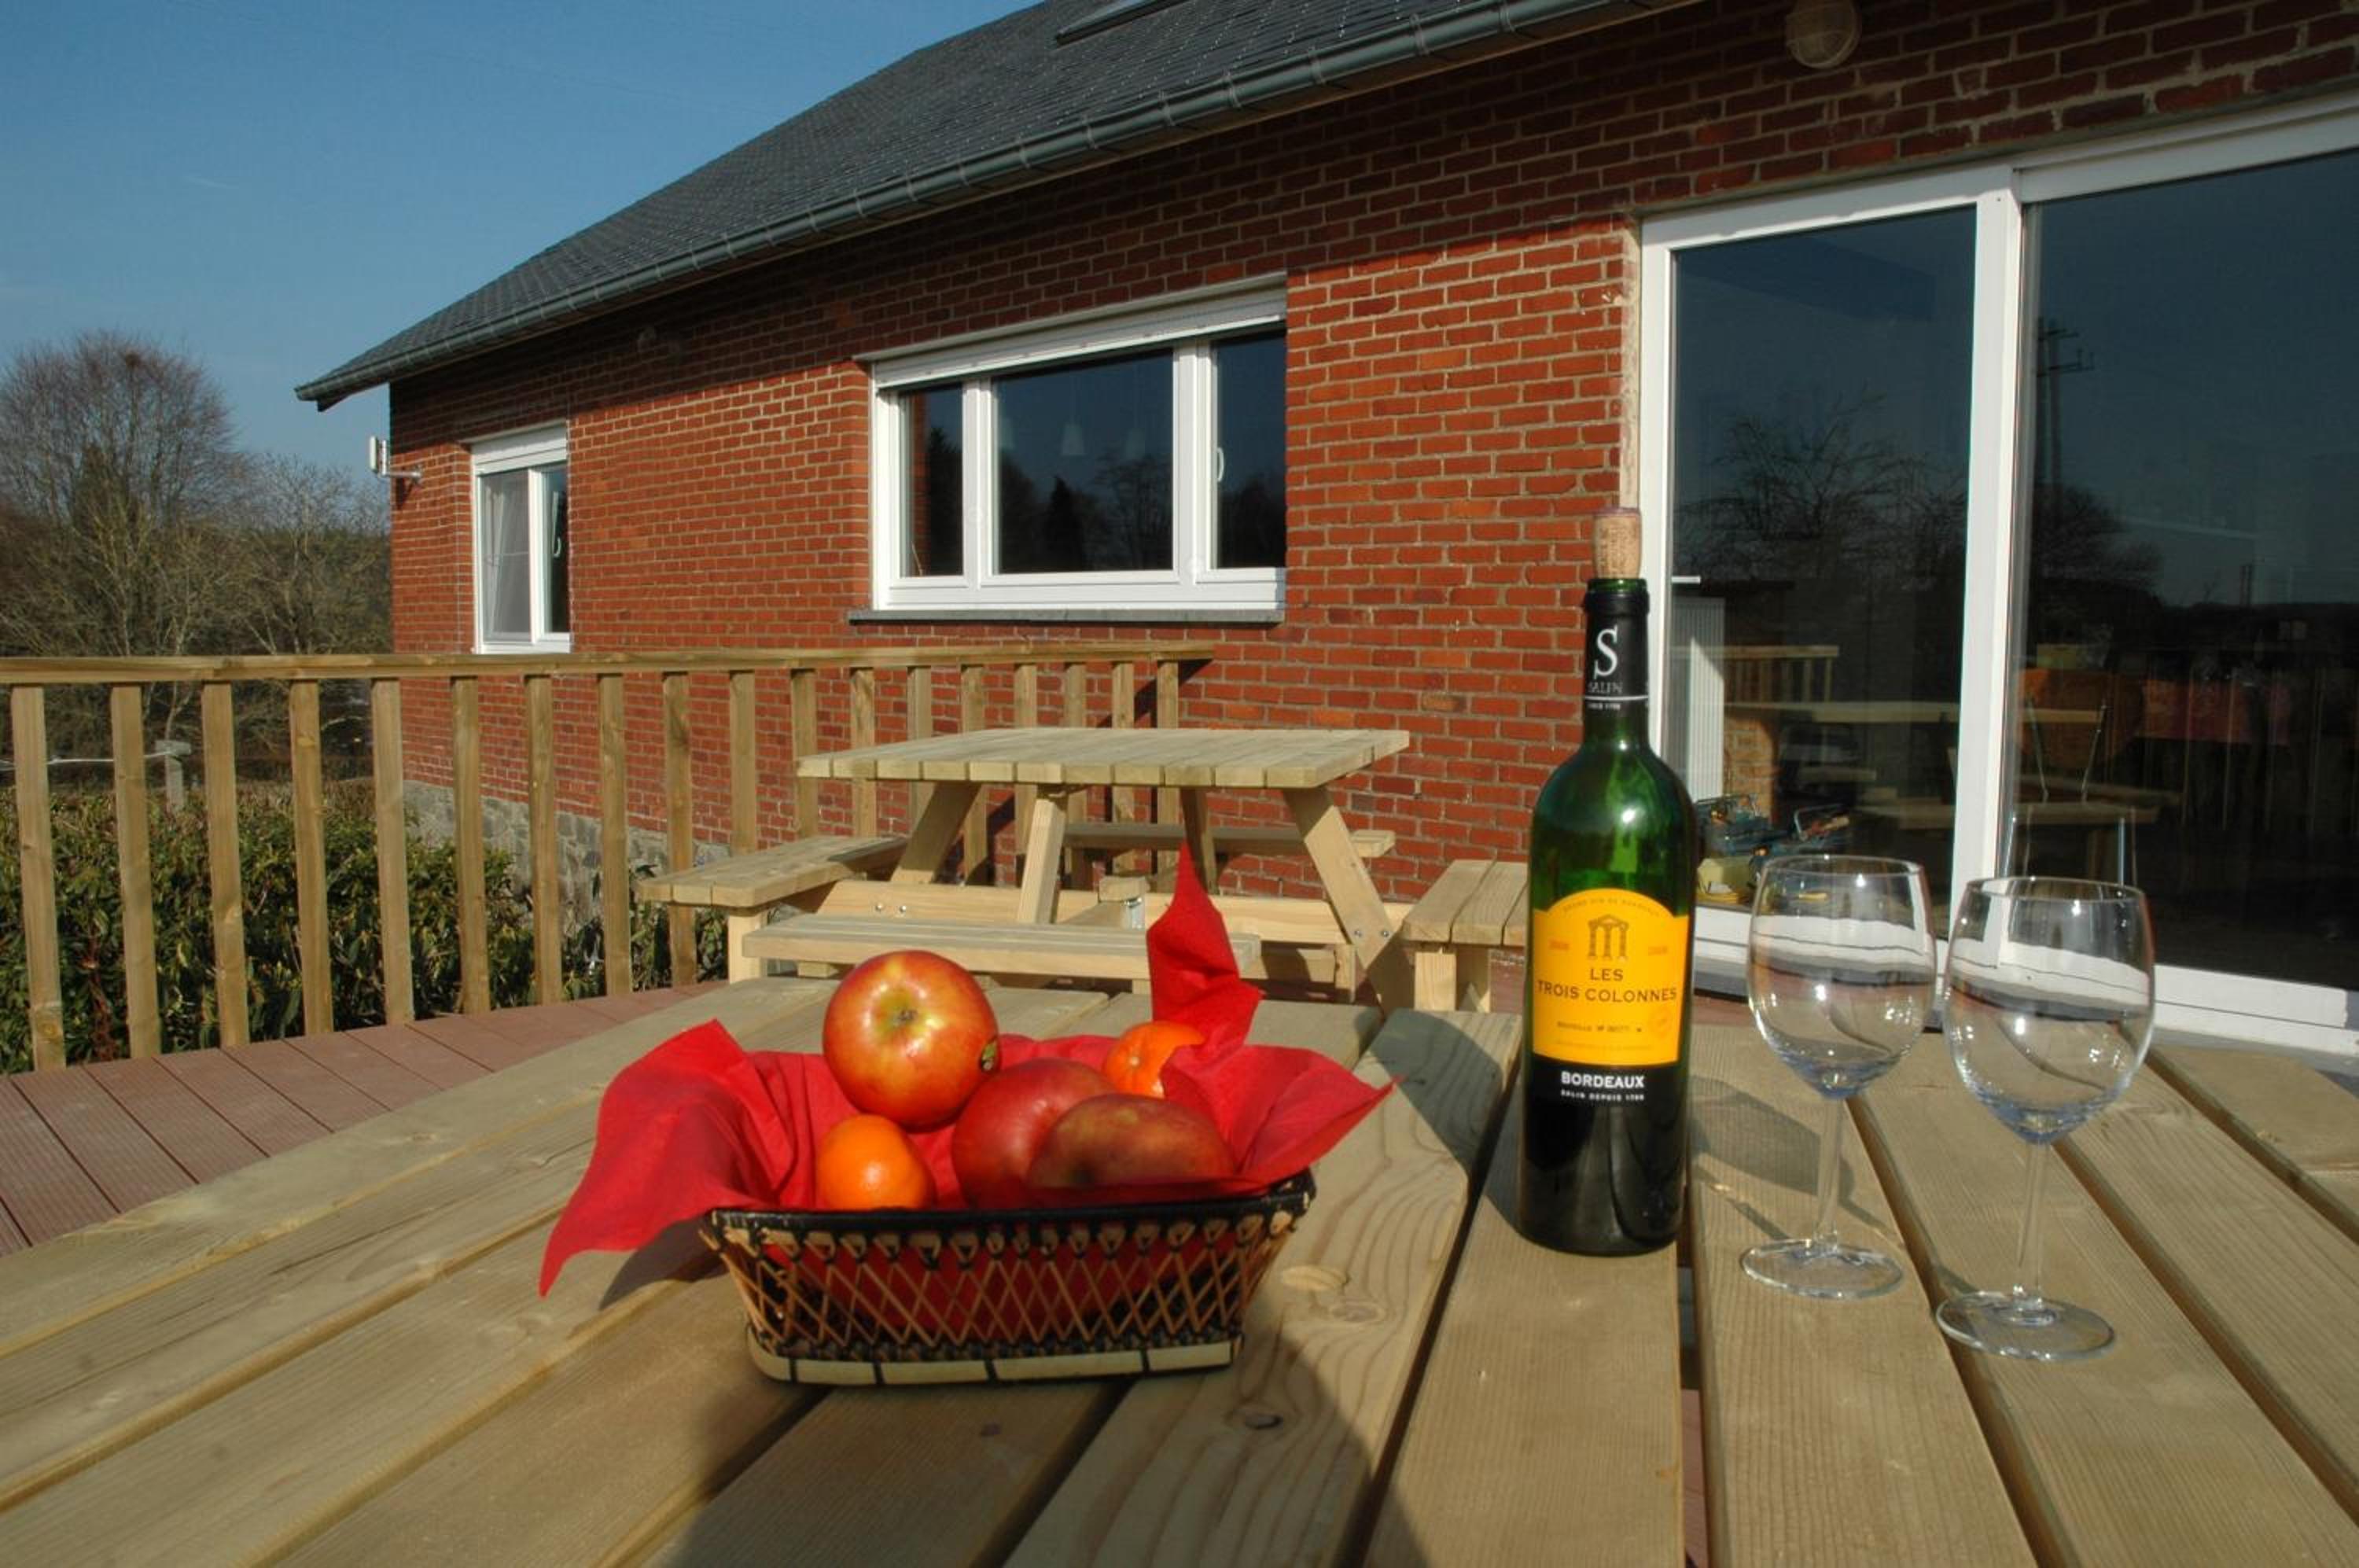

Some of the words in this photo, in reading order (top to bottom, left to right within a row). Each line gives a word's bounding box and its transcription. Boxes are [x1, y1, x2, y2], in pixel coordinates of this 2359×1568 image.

[1593, 624, 1618, 680] S
[1590, 968, 1623, 982] LES
[1536, 980, 1580, 1000] TROIS
[1584, 987, 1677, 1003] COLONNES
[1560, 1071, 1645, 1089] BORDEAUX
